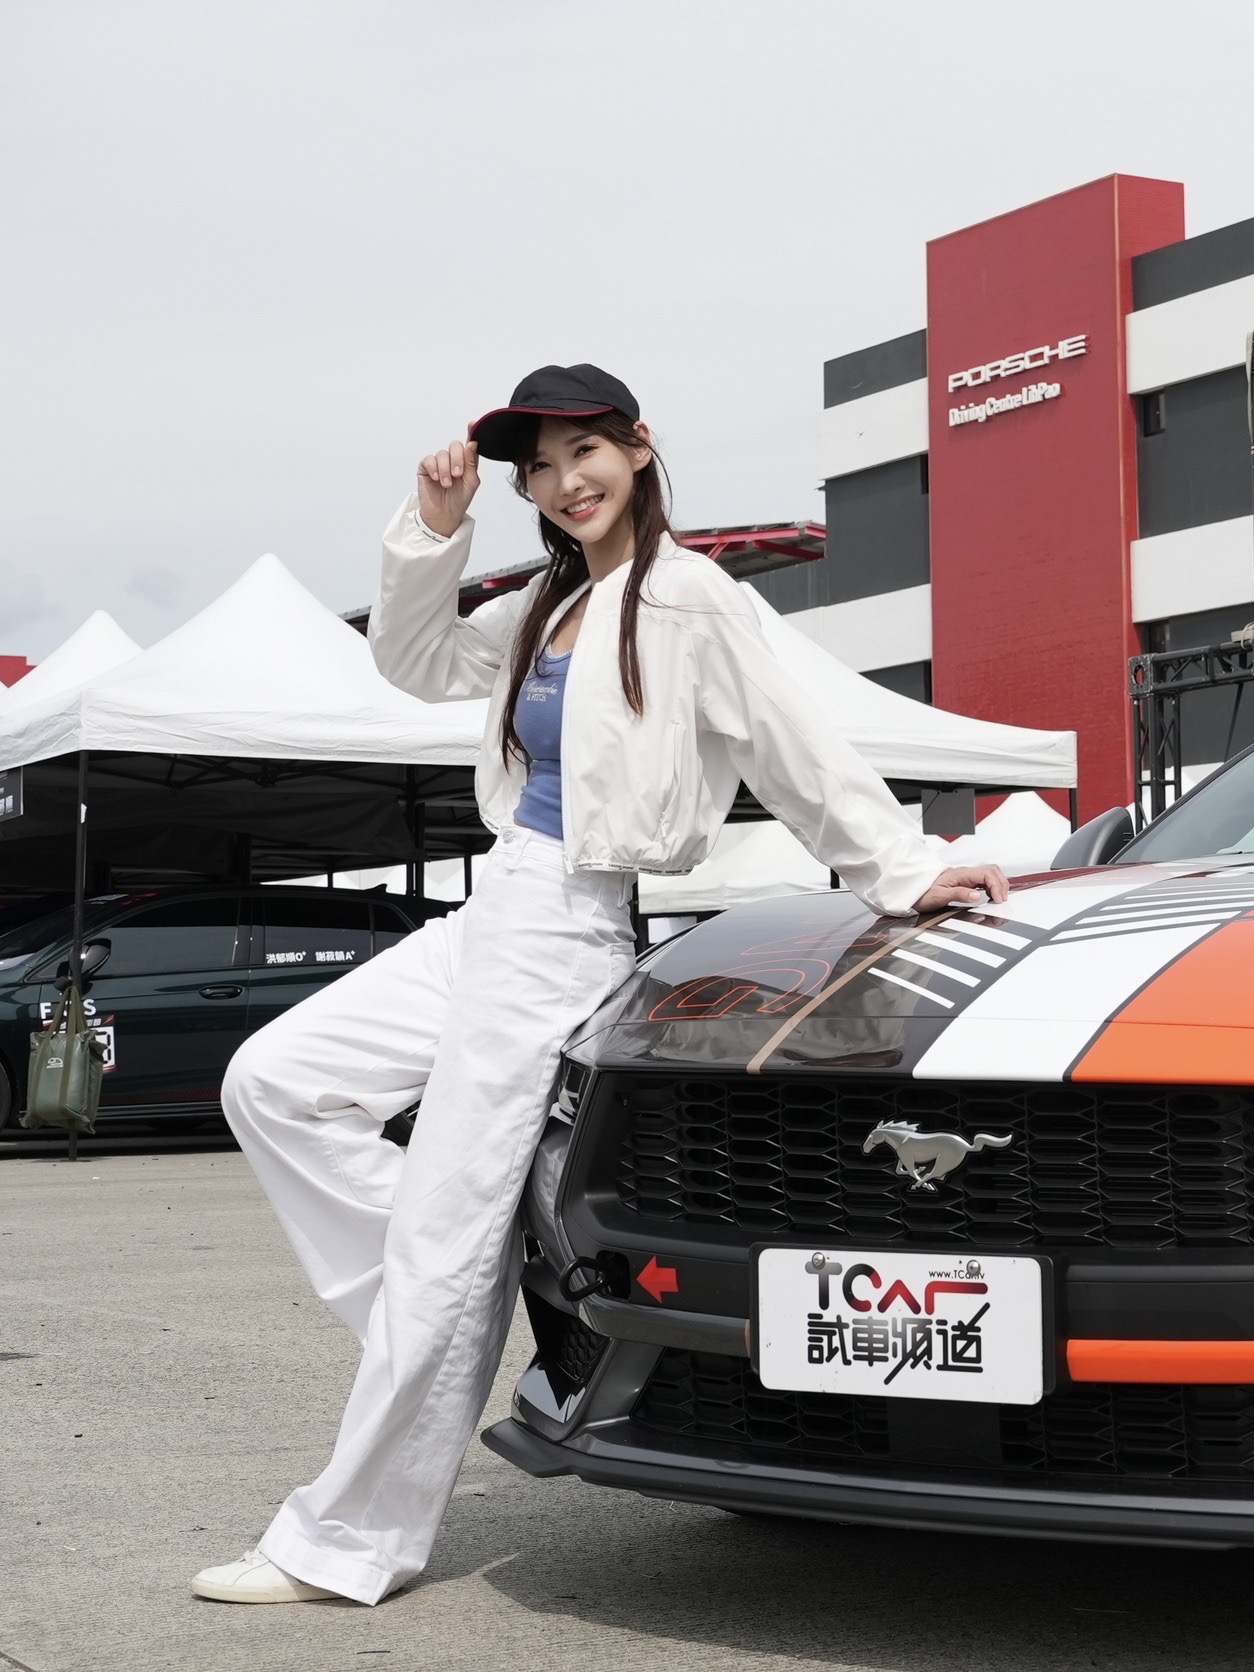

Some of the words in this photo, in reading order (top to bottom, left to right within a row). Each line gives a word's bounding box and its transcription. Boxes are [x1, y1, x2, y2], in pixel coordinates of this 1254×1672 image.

[948, 334, 1087, 392] PORSCHE
[948, 402, 987, 427] Driving
[807, 1302, 990, 1385] 試車頻道
